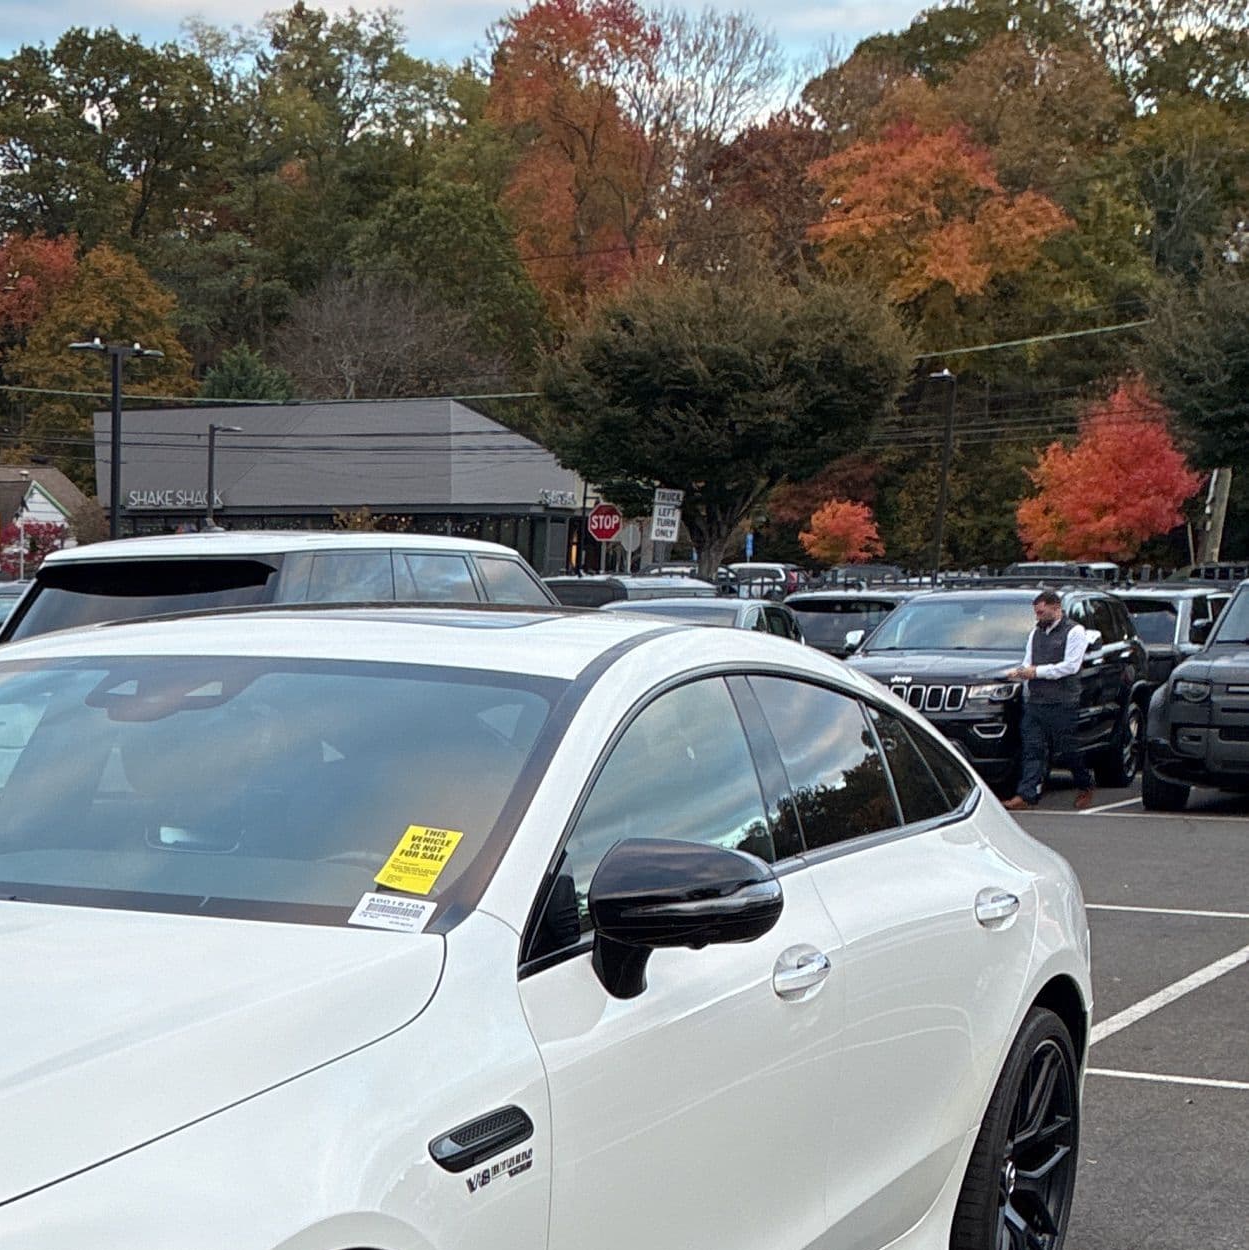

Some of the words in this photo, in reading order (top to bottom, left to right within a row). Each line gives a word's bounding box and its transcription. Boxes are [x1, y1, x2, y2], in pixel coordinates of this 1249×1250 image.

[129, 490, 173, 505] SHAKE
[657, 491, 681, 501] TRUCK
[658, 508, 676, 517] LEFT
[591, 515, 619, 530] STOP
[656, 518, 676, 528] TURN
[655, 528, 674, 538] ONLY
[424, 829, 447, 838] THIS
[411, 835, 452, 847] VEHICLE
[410, 843, 421, 851] IS
[422, 844, 444, 853] NOT
[399, 849, 419, 858] FOR
[420, 852, 445, 862] SALE
[466, 1168, 490, 1193] V8
